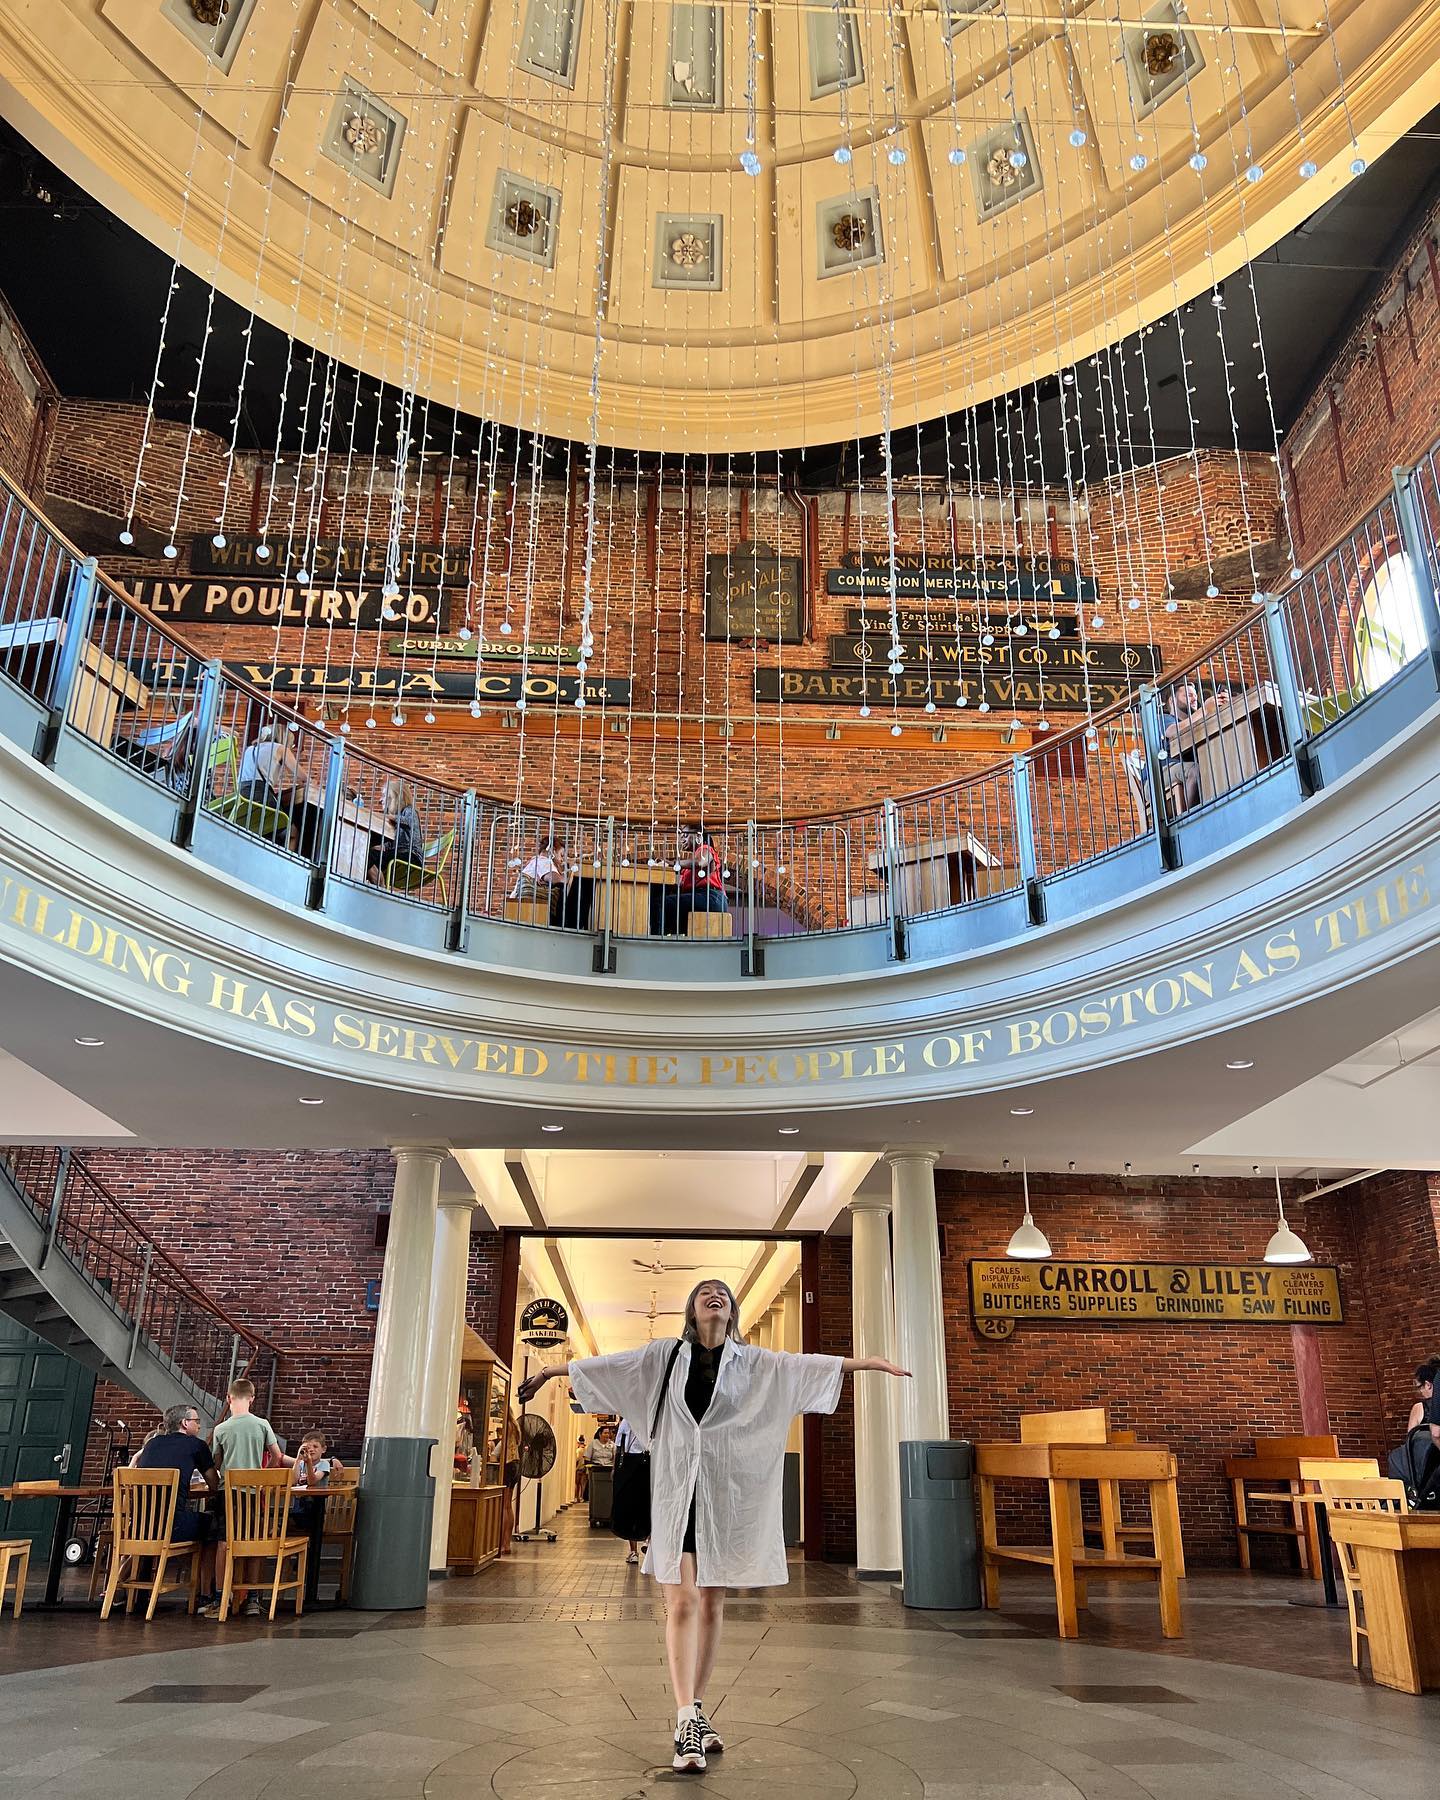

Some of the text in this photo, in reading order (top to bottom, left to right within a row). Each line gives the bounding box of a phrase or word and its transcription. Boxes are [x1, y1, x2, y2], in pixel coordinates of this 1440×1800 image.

[874, 555, 922, 568] WNN,
[1005, 560, 1016, 571] &
[838, 575, 1006, 590] COMMISION MERCHANTS
[204, 584, 369, 619] POULTRY
[382, 593, 436, 623] CO.
[902, 620, 911, 630] &
[402, 639, 468, 652] CURLY
[242, 665, 446, 692] VILLA
[478, 676, 568, 697] CO.
[989, 679, 1129, 705] VARNEY
[207, 971, 317, 1037] HAS
[331, 1014, 548, 1077] SERVED
[565, 1051, 678, 1085] THE
[697, 1043, 905, 1085] PEOPLE
[923, 1028, 993, 1070] OF
[1006, 961, 1214, 1057] BOSTON
[1229, 928, 1301, 992] AS
[1314, 863, 1431, 954] THE
[981, 1274, 1010, 1283] DISPLAY
[989, 1267, 1021, 1275] SCALES
[1290, 1272, 1316, 1281] SAWS
[991, 1282, 1020, 1290] KNIVES
[1039, 1265, 1271, 1296] CARROLL & LILEY
[1282, 1280, 1325, 1288] CLEAVERS
[1286, 1288, 1324, 1296] CUTLERY
[524, 1301, 550, 1318] NORTH
[983, 1292, 1331, 1316] BUTCHERS SUPPLIES GRINDING SAW FILING
[984, 1319, 1008, 1334] 26
